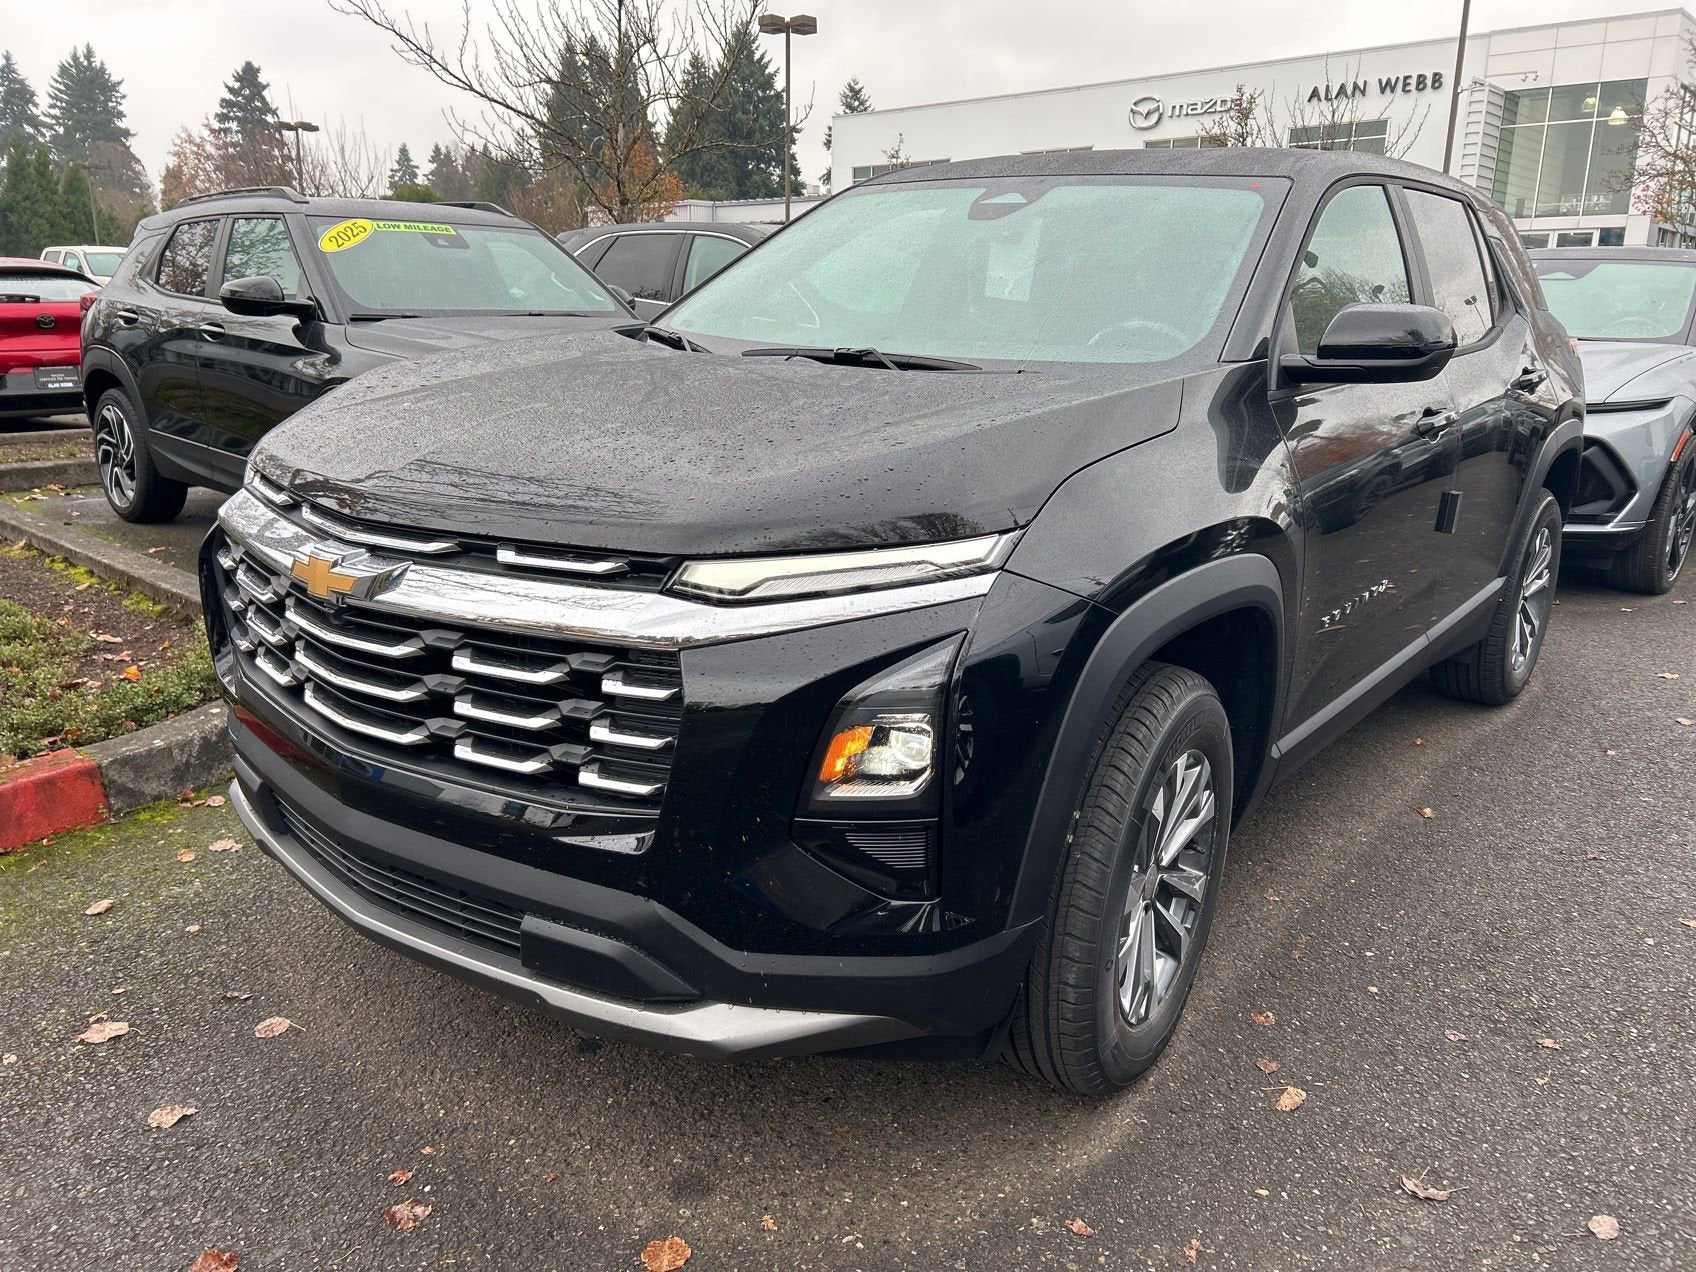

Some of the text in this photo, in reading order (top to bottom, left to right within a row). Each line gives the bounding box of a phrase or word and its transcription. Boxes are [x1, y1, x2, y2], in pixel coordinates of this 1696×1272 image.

[1306, 71, 1444, 103] ALAN WEBB
[328, 221, 368, 249] 2025
[376, 222, 452, 233] LOW MILEAGE
